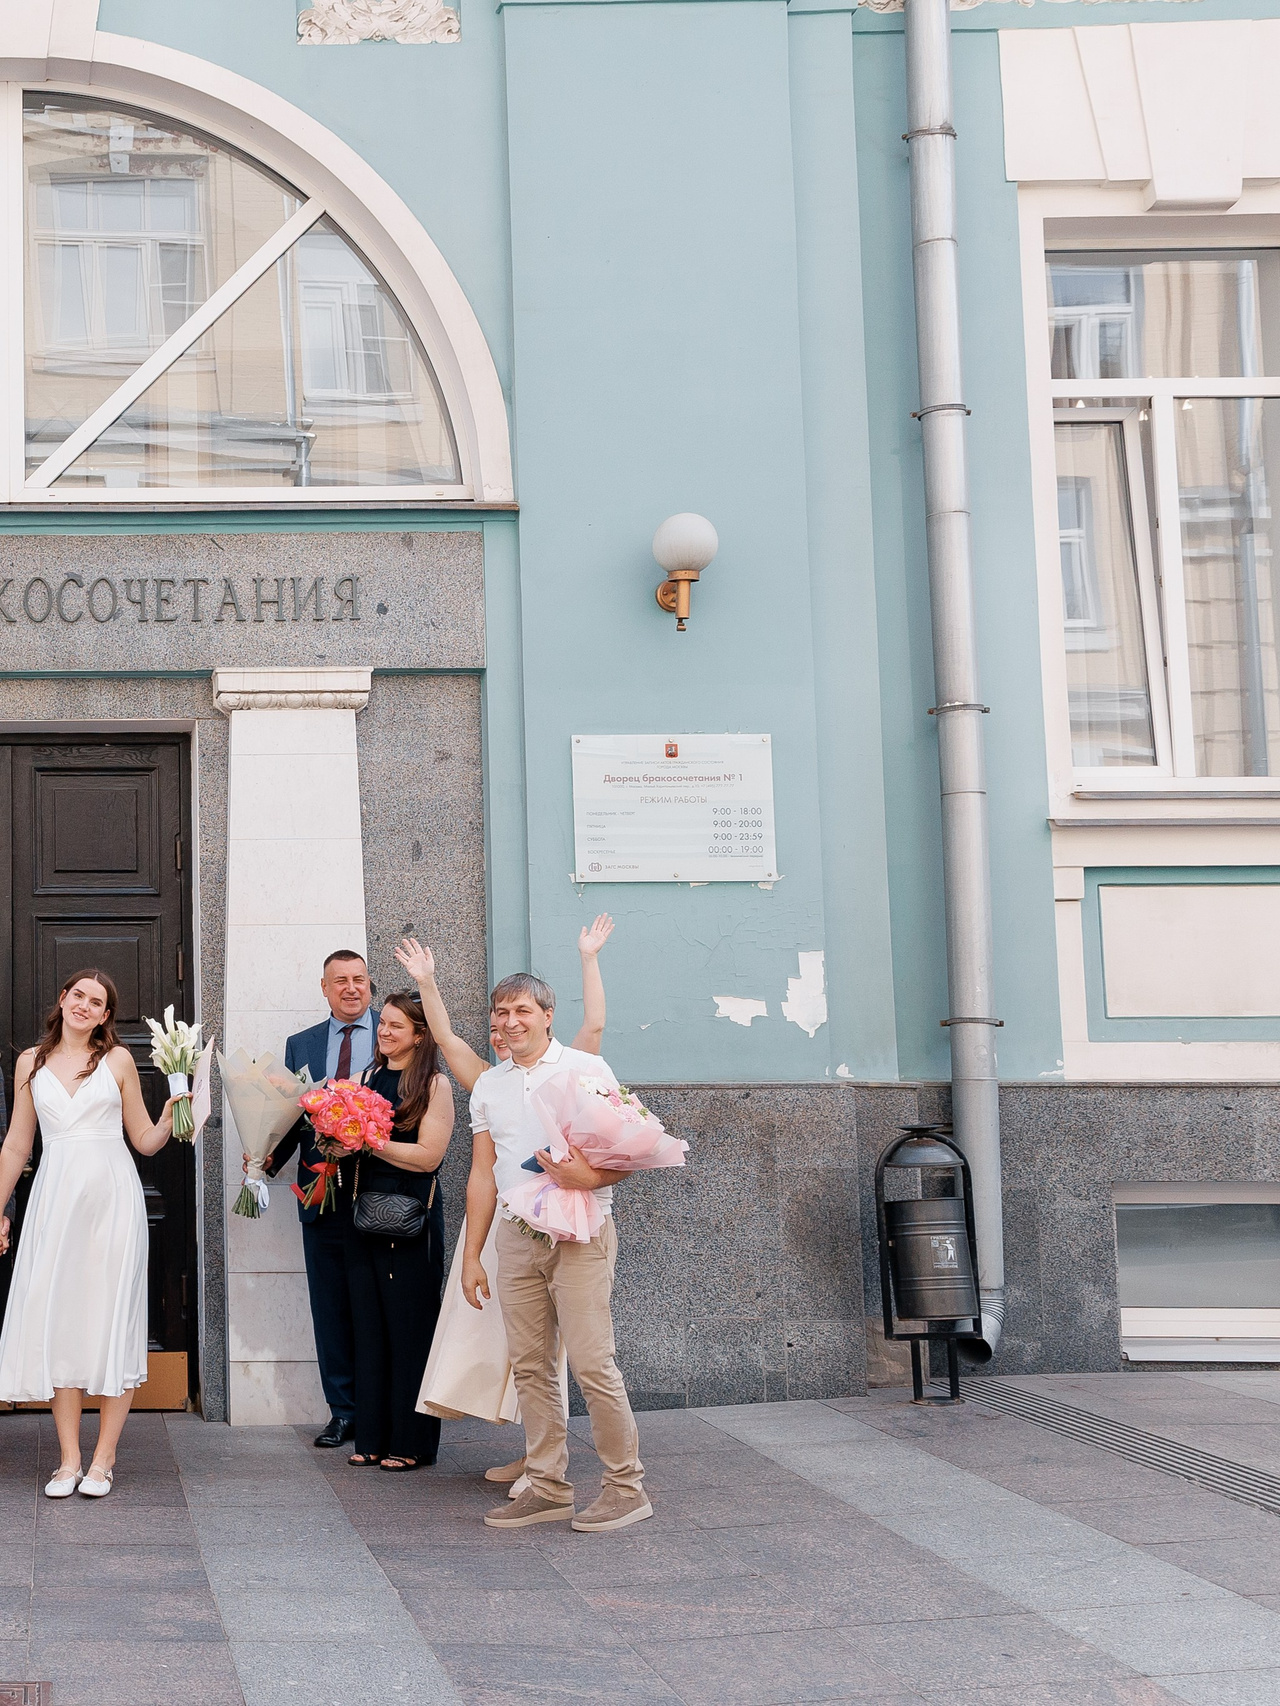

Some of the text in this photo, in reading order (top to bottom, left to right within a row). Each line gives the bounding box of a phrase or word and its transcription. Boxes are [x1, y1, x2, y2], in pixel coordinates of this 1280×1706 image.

[603, 773, 743, 784] Дворец бракосочетания № 1
[640, 795, 707, 804] РЕЖИМ РАБОТЫ
[712, 807, 731, 815] 9:00
[740, 807, 762, 815] 18:00
[713, 820, 732, 828] 9:00
[738, 820, 763, 828] 20:00
[713, 833, 732, 841] 9:00
[739, 832, 763, 840] 23:59
[708, 845, 733, 853] 00:00
[741, 845, 764, 853] 19:00
